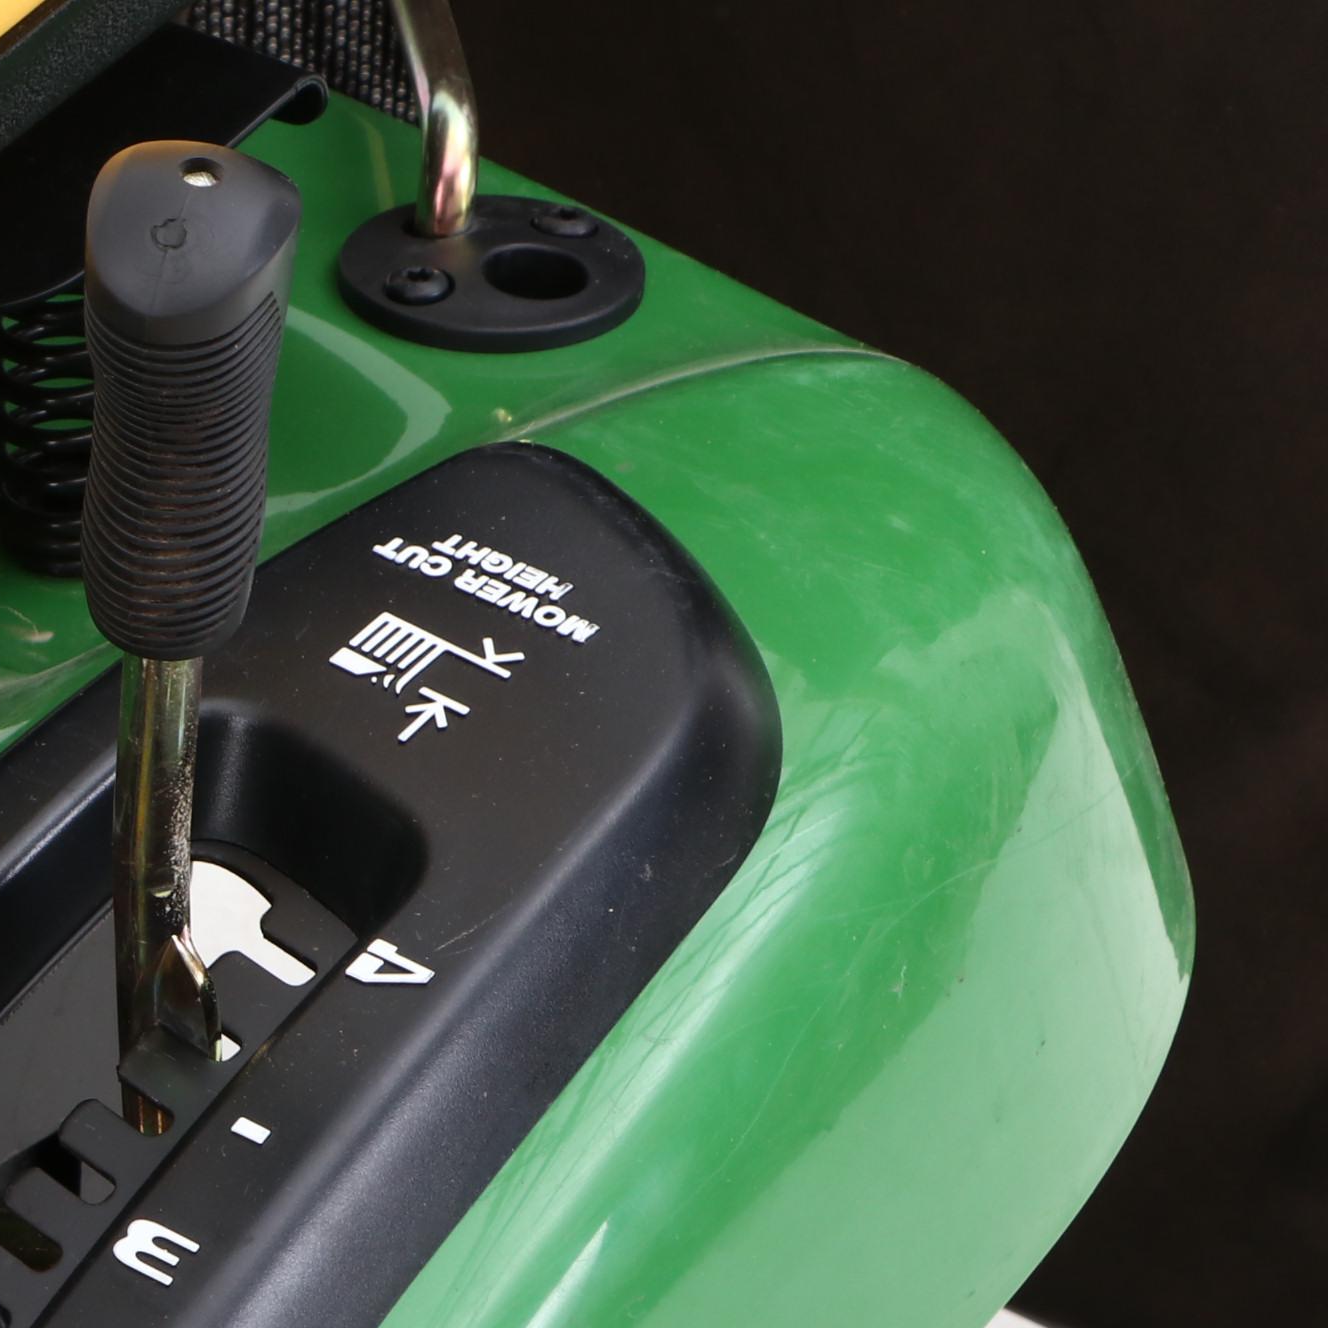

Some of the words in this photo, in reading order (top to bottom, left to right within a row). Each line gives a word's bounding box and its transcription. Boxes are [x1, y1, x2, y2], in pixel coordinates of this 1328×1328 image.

[372, 537, 453, 577] CUT
[431, 534, 573, 601] HEIGHT
[454, 569, 600, 643] MOWER
[345, 938, 435, 985] 4
[112, 1218, 200, 1286] 3
